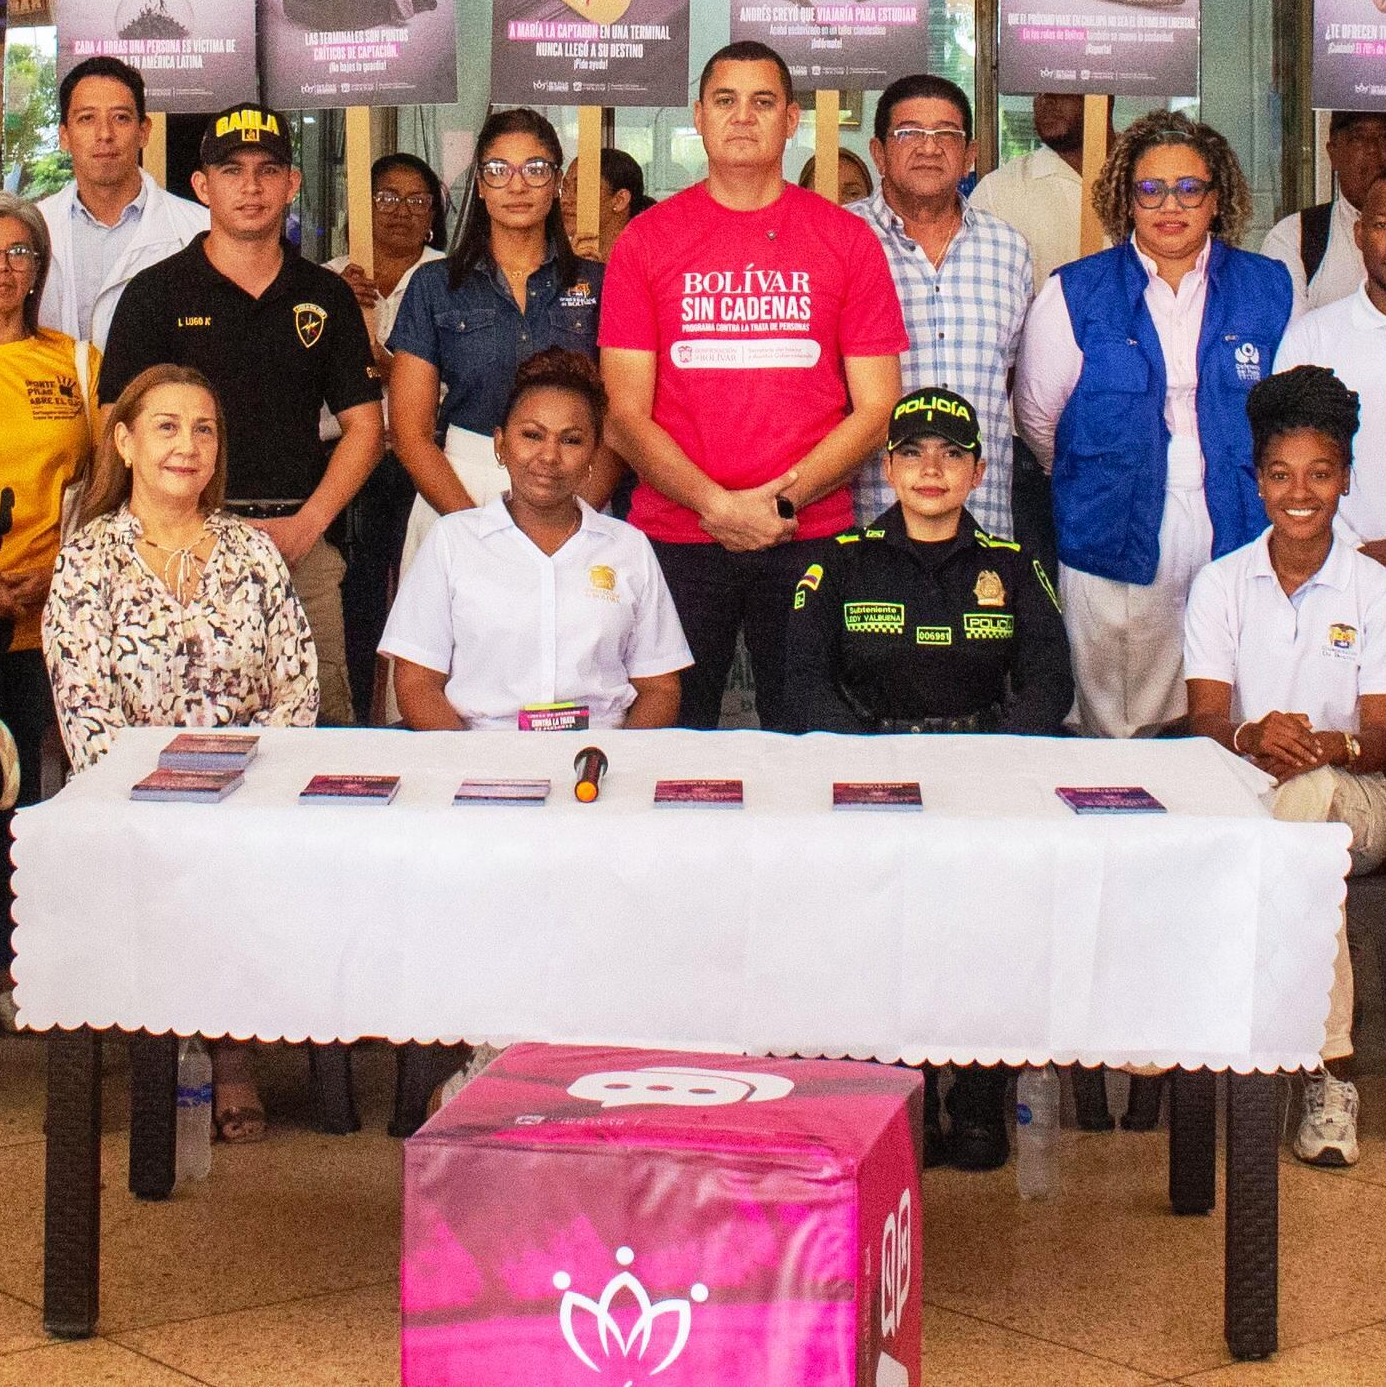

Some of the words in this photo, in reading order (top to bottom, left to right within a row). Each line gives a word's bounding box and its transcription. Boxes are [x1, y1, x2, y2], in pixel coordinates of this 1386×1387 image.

[740, 5, 772, 22] ANDRÉS
[801, 7, 815, 23] QUE
[817, 5, 854, 22] VIAJARÍA
[856, 7, 876, 22] PARA
[878, 7, 917, 22] ESTUDIAR
[305, 32, 319, 45] LAS
[319, 30, 364, 44] TERMINALES
[365, 30, 379, 42] SON
[516, 21, 543, 38] MARÍA
[546, 23, 556, 38] LA
[557, 24, 598, 39] CAPTARON
[600, 25, 610, 39] EN
[613, 25, 628, 39] UNA
[631, 26, 671, 40] TERMINAL
[226, 40, 236, 52] DE
[347, 45, 356, 59] DE
[536, 43, 563, 57] NUNCA
[565, 41, 588, 57] LLEGÓ
[598, 44, 608, 57] SU
[610, 45, 643, 58] DESTINO
[176, 55, 203, 68] LATINA
[682, 263, 811, 294] BOLÍVAR
[681, 297, 714, 322] SIN
[721, 296, 811, 321] CADENAS
[716, 324, 740, 332] CONTRA
[741, 324, 749, 332] LA
[751, 323, 770, 331] TRATA
[770, 323, 778, 331] DE
[779, 323, 810, 332] PERSONAS
[892, 395, 972, 422] POLICÍA
